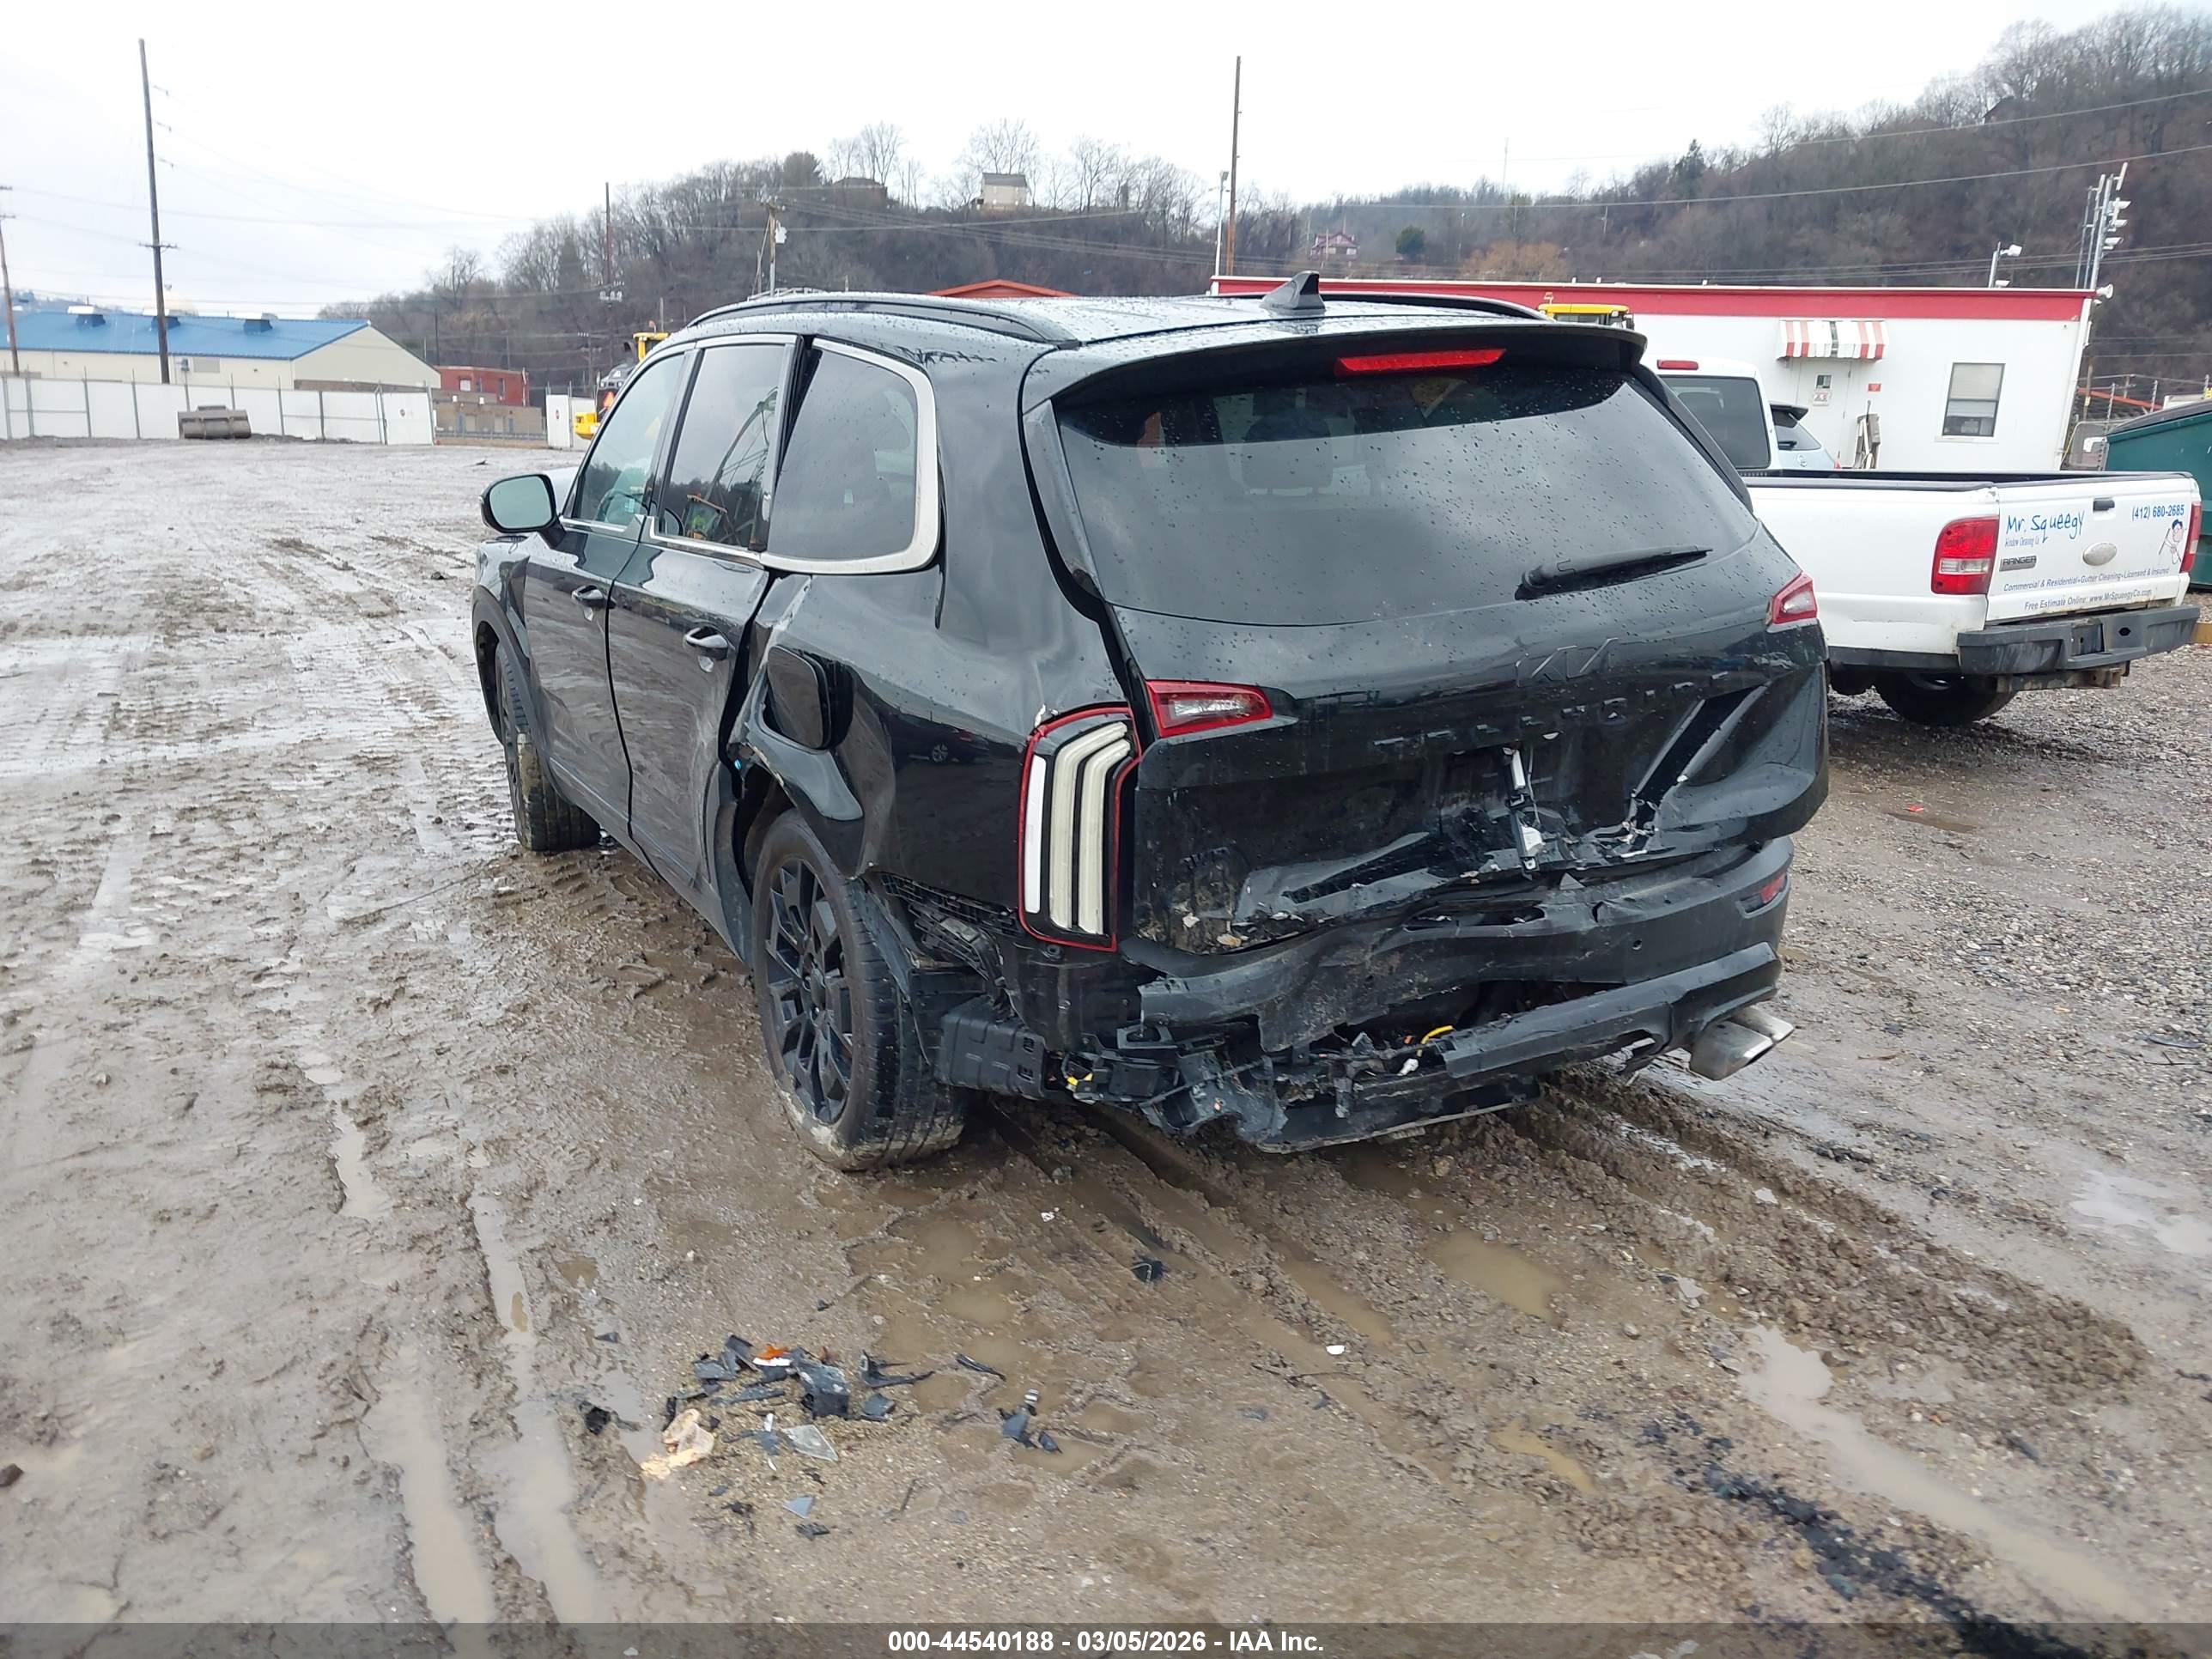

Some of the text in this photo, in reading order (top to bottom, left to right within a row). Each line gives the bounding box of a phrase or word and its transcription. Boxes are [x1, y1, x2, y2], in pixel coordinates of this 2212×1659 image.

[2132, 504, 2185, 522] (412) 680-2685
[2006, 510, 2085, 543] Mr. Squeegy
[2003, 555, 2037, 566] RANGER
[2004, 580, 2039, 592] Commercial
[2025, 601, 2039, 611] Free
[2040, 598, 2066, 609] Estimate
